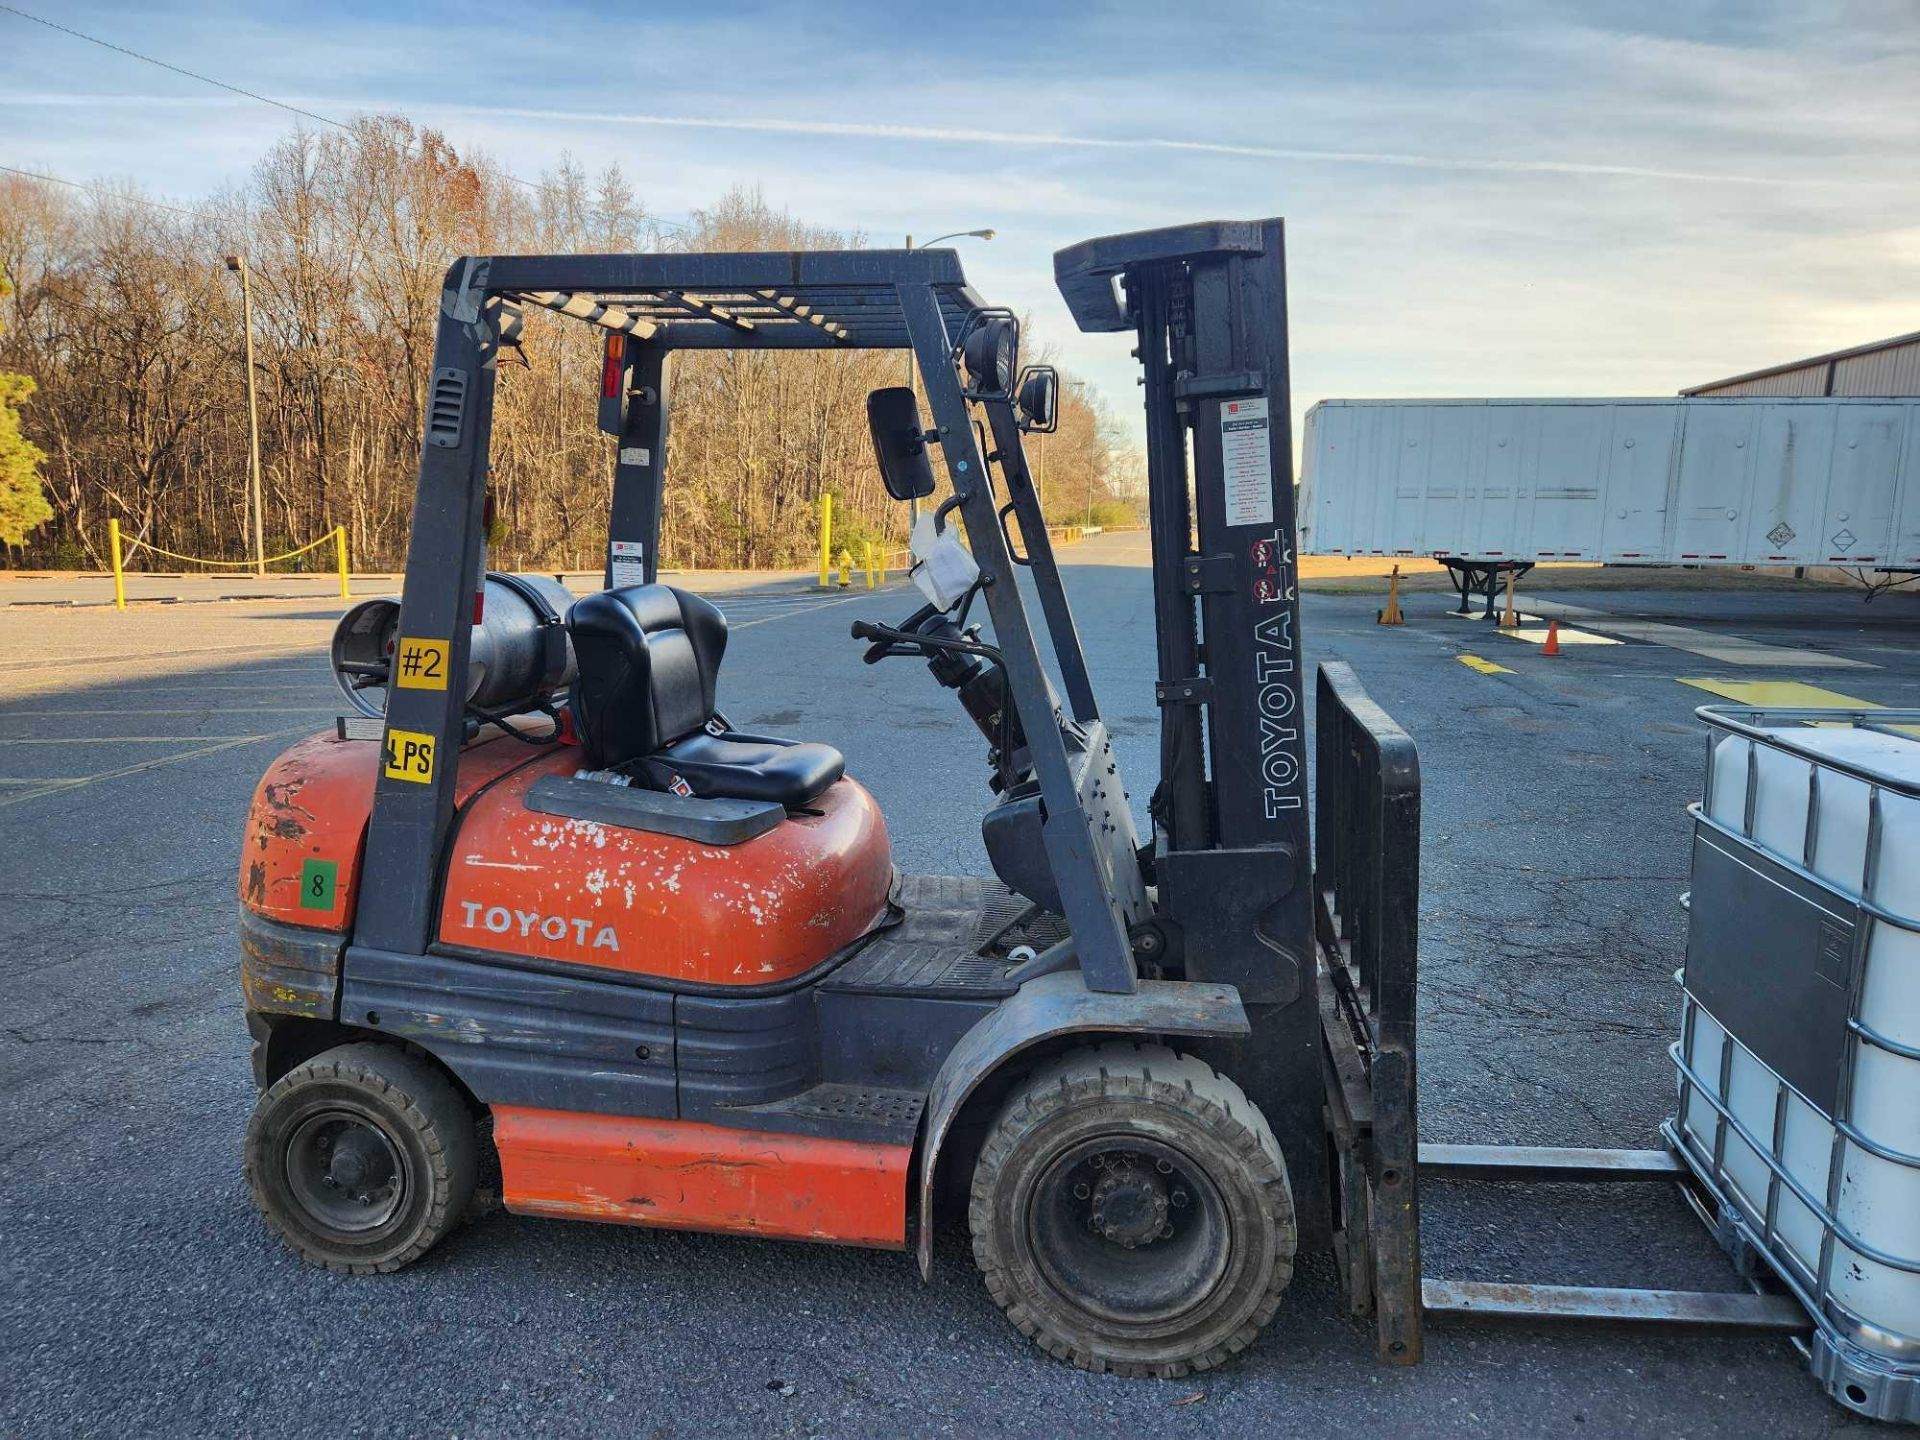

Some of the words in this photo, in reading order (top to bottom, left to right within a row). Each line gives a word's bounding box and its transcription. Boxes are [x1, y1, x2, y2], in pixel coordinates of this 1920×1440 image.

[402, 646, 442, 678] #2
[1254, 610, 1302, 819] TOYOTA
[388, 738, 432, 775] LPS
[312, 873, 325, 898] 8
[460, 900, 620, 952] TOYOTA
